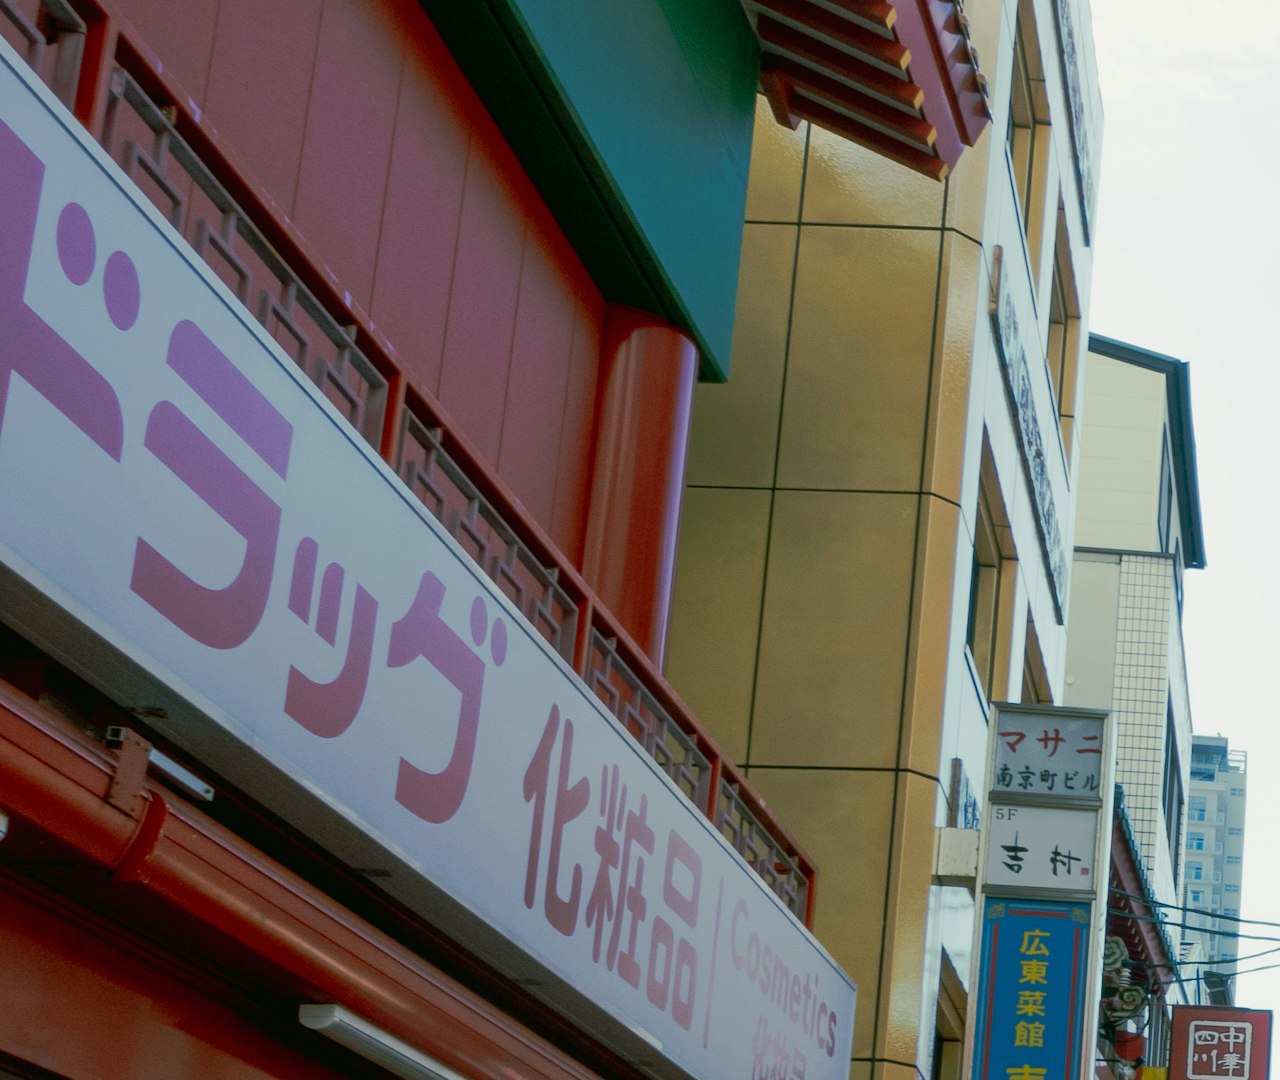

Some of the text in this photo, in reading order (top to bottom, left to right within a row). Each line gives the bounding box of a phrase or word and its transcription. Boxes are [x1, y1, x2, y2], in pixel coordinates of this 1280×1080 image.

[0, 118, 508, 824] ドラッグ
[996, 764, 1100, 792] 南京町ビル
[998, 728, 1103, 758] マサニ
[995, 808, 1019, 821] 5F
[1000, 831, 1082, 876] 吉村
[522, 703, 703, 1031] 化粧品
[729, 899, 838, 1059] Cosmetics
[1013, 929, 1051, 1049] 広東菜館
